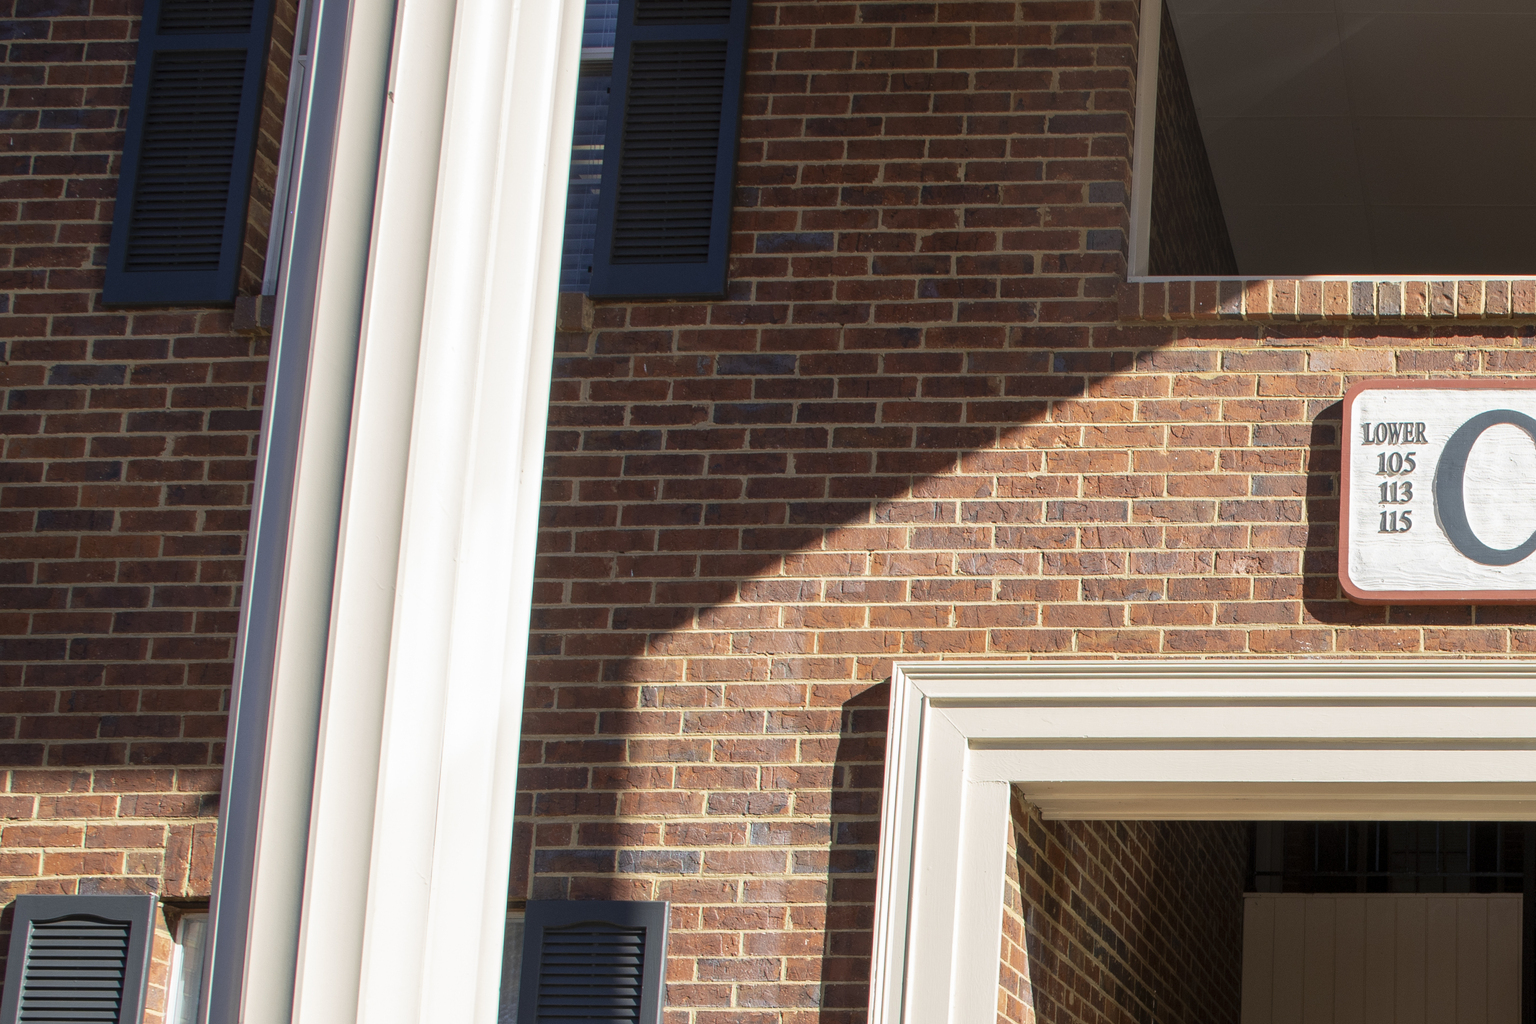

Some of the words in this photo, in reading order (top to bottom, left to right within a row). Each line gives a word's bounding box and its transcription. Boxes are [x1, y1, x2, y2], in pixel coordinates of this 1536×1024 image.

[1361, 421, 1430, 446] LOWER
[1376, 451, 1417, 477] 105
[1378, 480, 1414, 505] 113
[1378, 509, 1413, 534] 115
